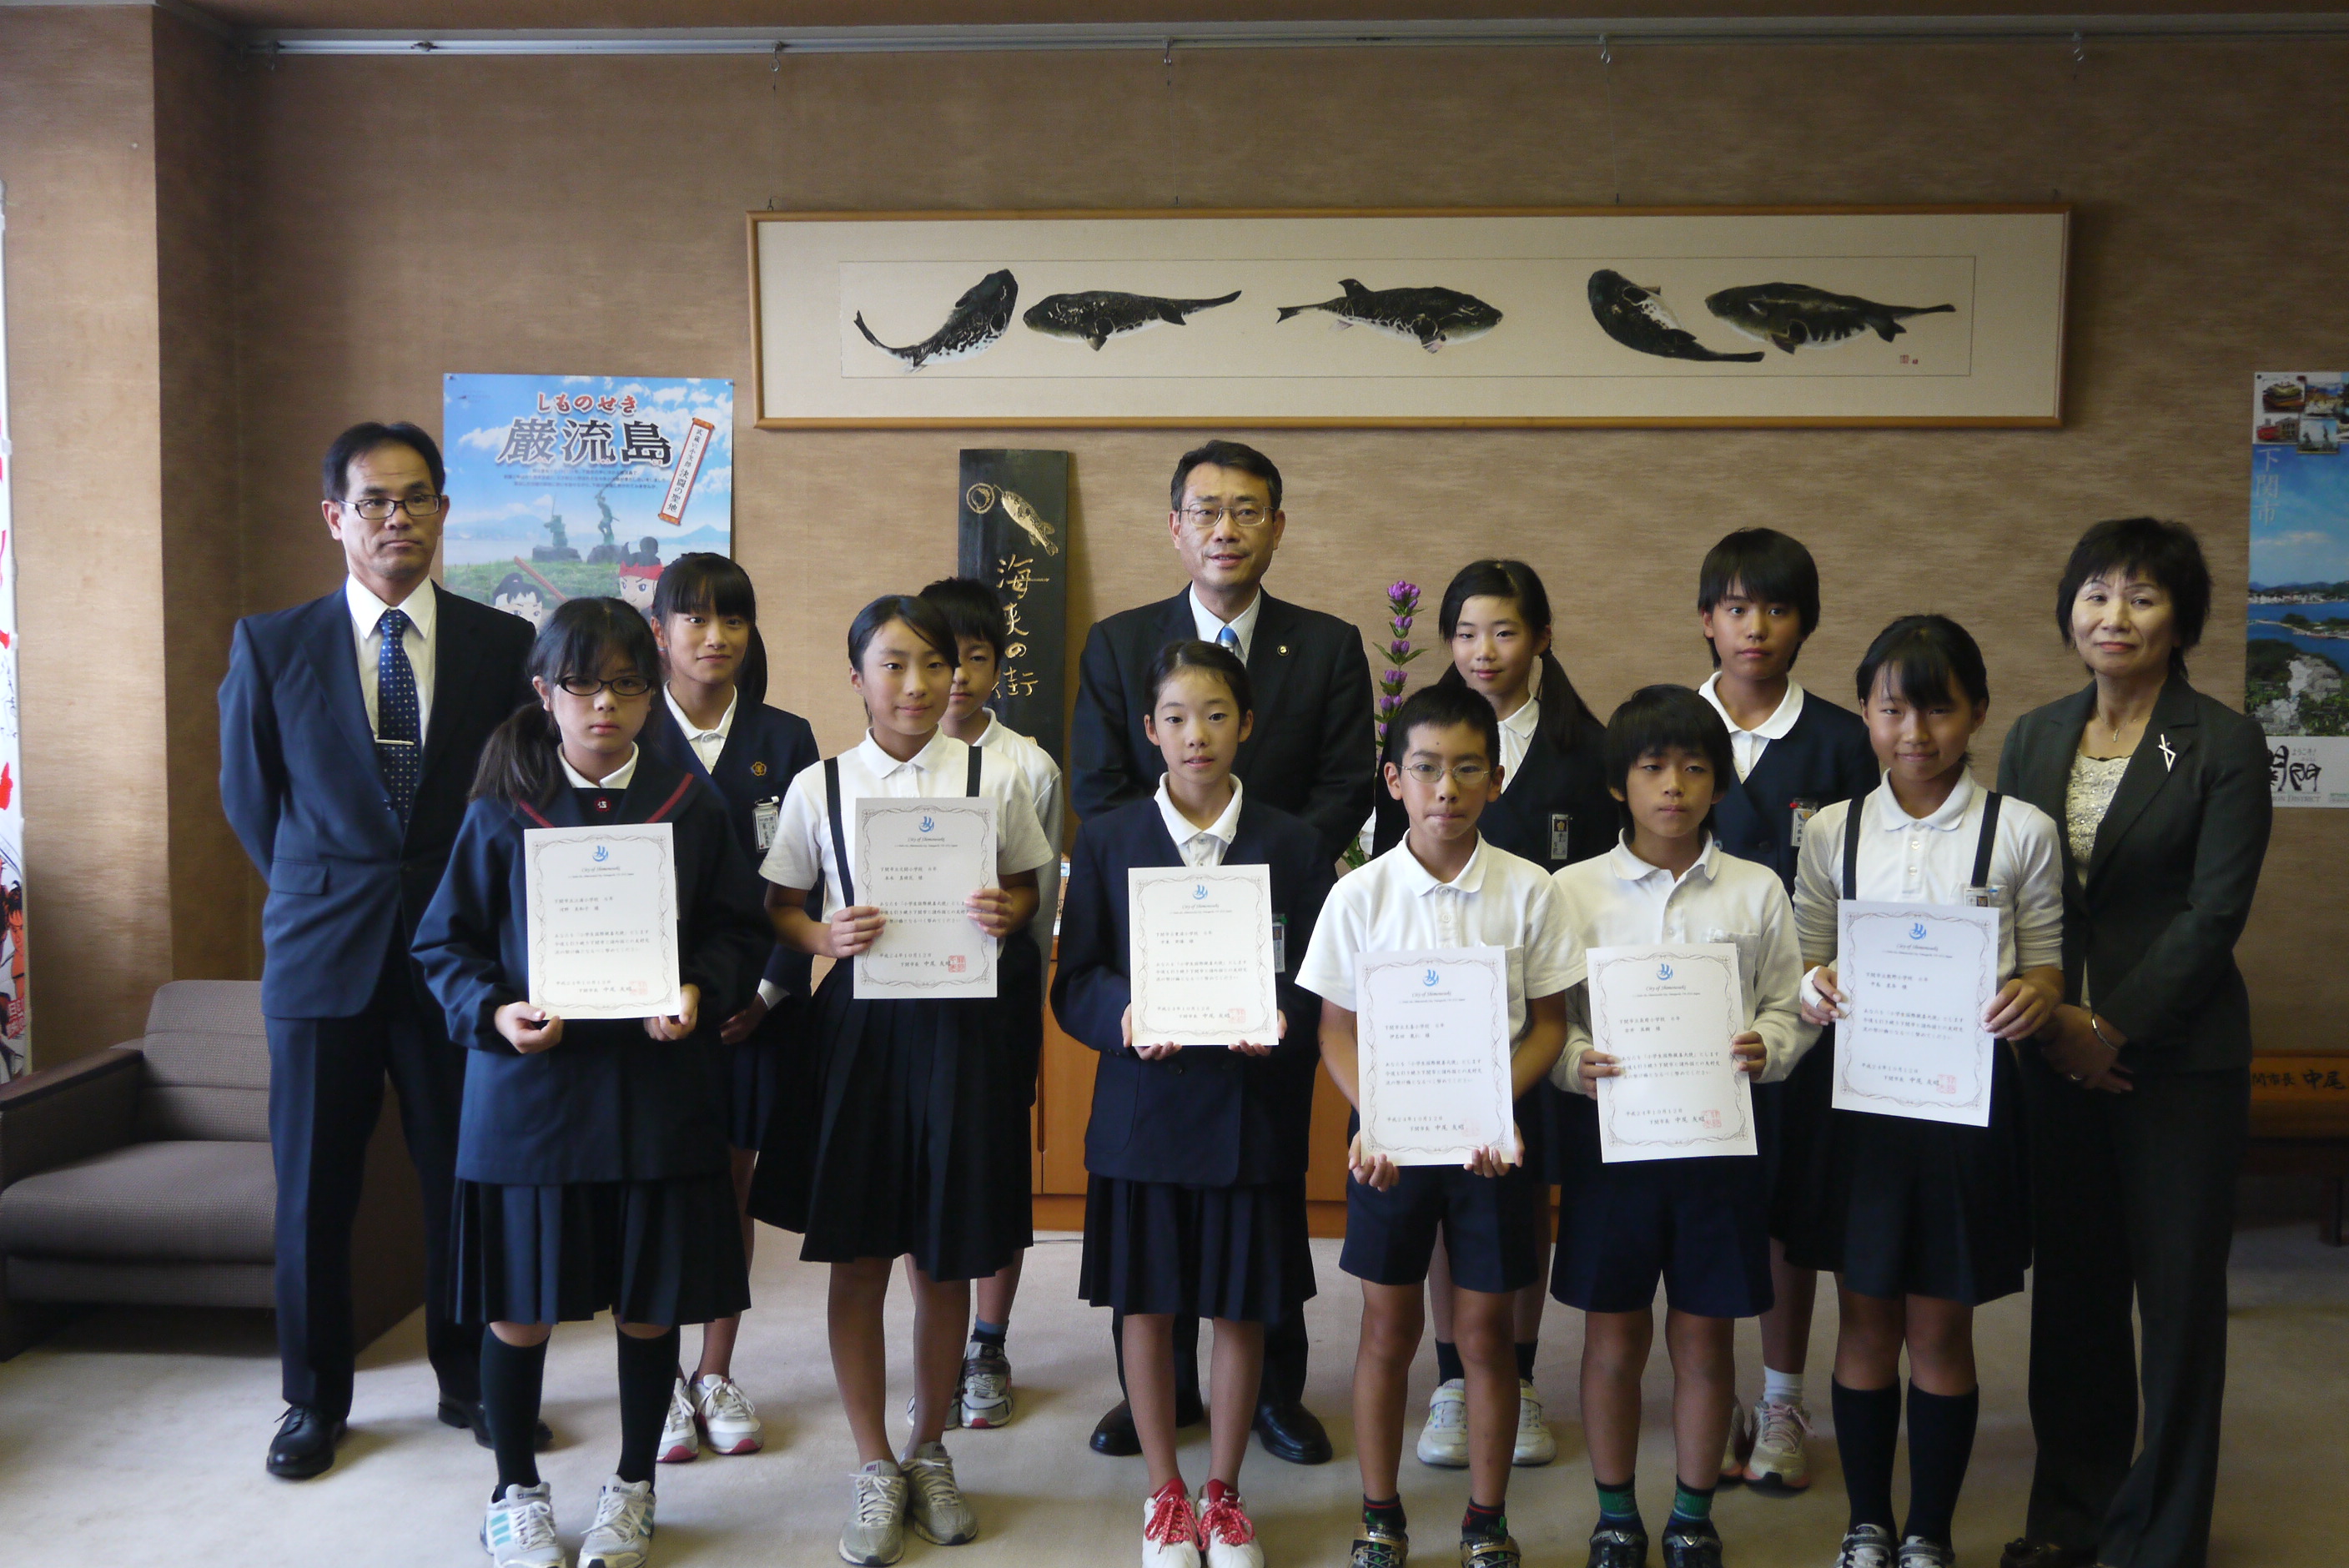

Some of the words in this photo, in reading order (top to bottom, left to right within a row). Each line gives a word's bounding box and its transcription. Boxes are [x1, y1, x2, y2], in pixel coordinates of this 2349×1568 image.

[539, 394, 636, 413] しものせき
[497, 418, 672, 465] 巌流島
[2254, 447, 2281, 526] 下関市
